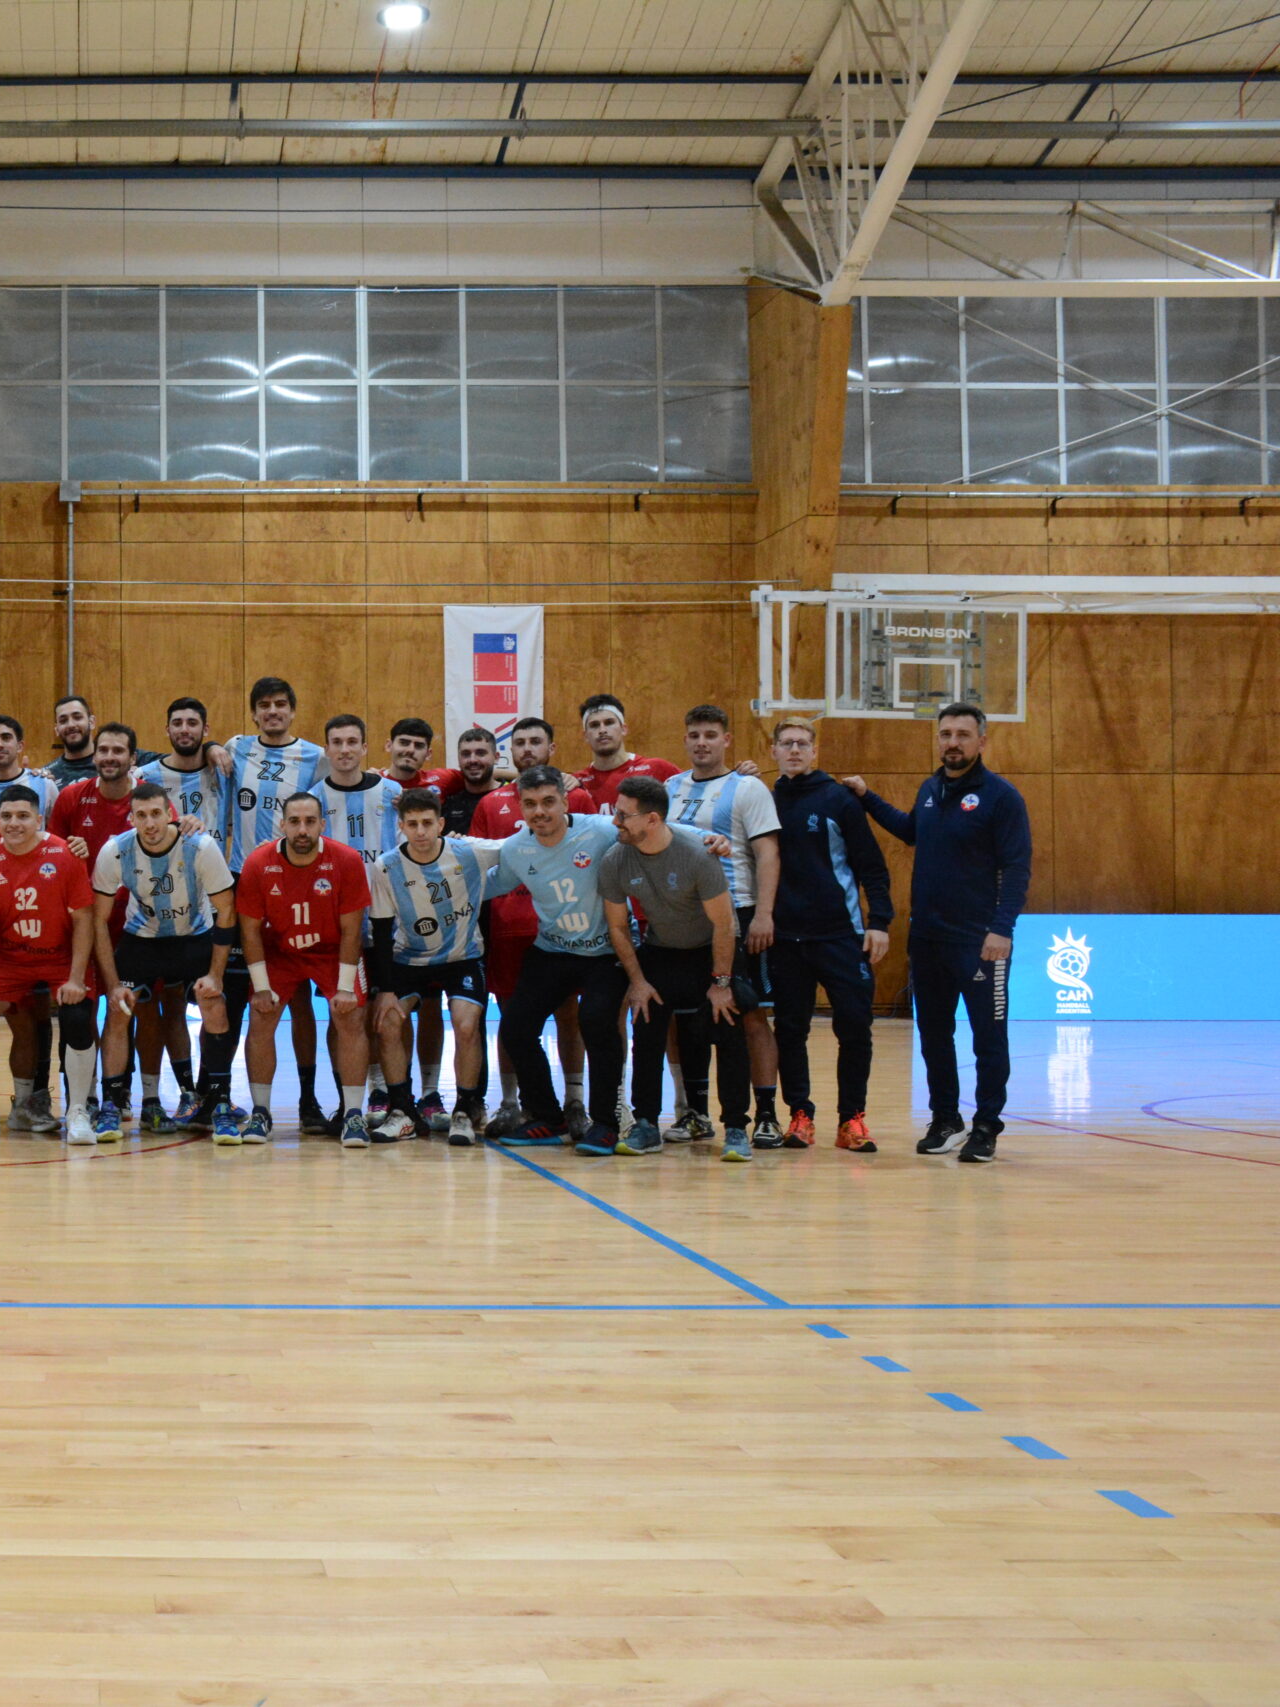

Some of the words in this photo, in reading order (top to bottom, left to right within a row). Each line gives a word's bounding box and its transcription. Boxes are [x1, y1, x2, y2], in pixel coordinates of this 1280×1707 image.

[884, 626, 970, 638] BRONSON
[257, 760, 286, 782] 22
[179, 791, 203, 814] 19
[263, 796, 286, 810] BN
[676, 799, 705, 821] 77
[347, 814, 364, 838] 11
[149, 873, 174, 897] 20
[426, 879, 452, 904] 21
[549, 877, 579, 903] 12
[14, 887, 38, 910] 32
[162, 904, 192, 920] BNA
[291, 902, 310, 925] 11
[443, 902, 474, 926] BNA
[1056, 990, 1087, 1001] CAH
